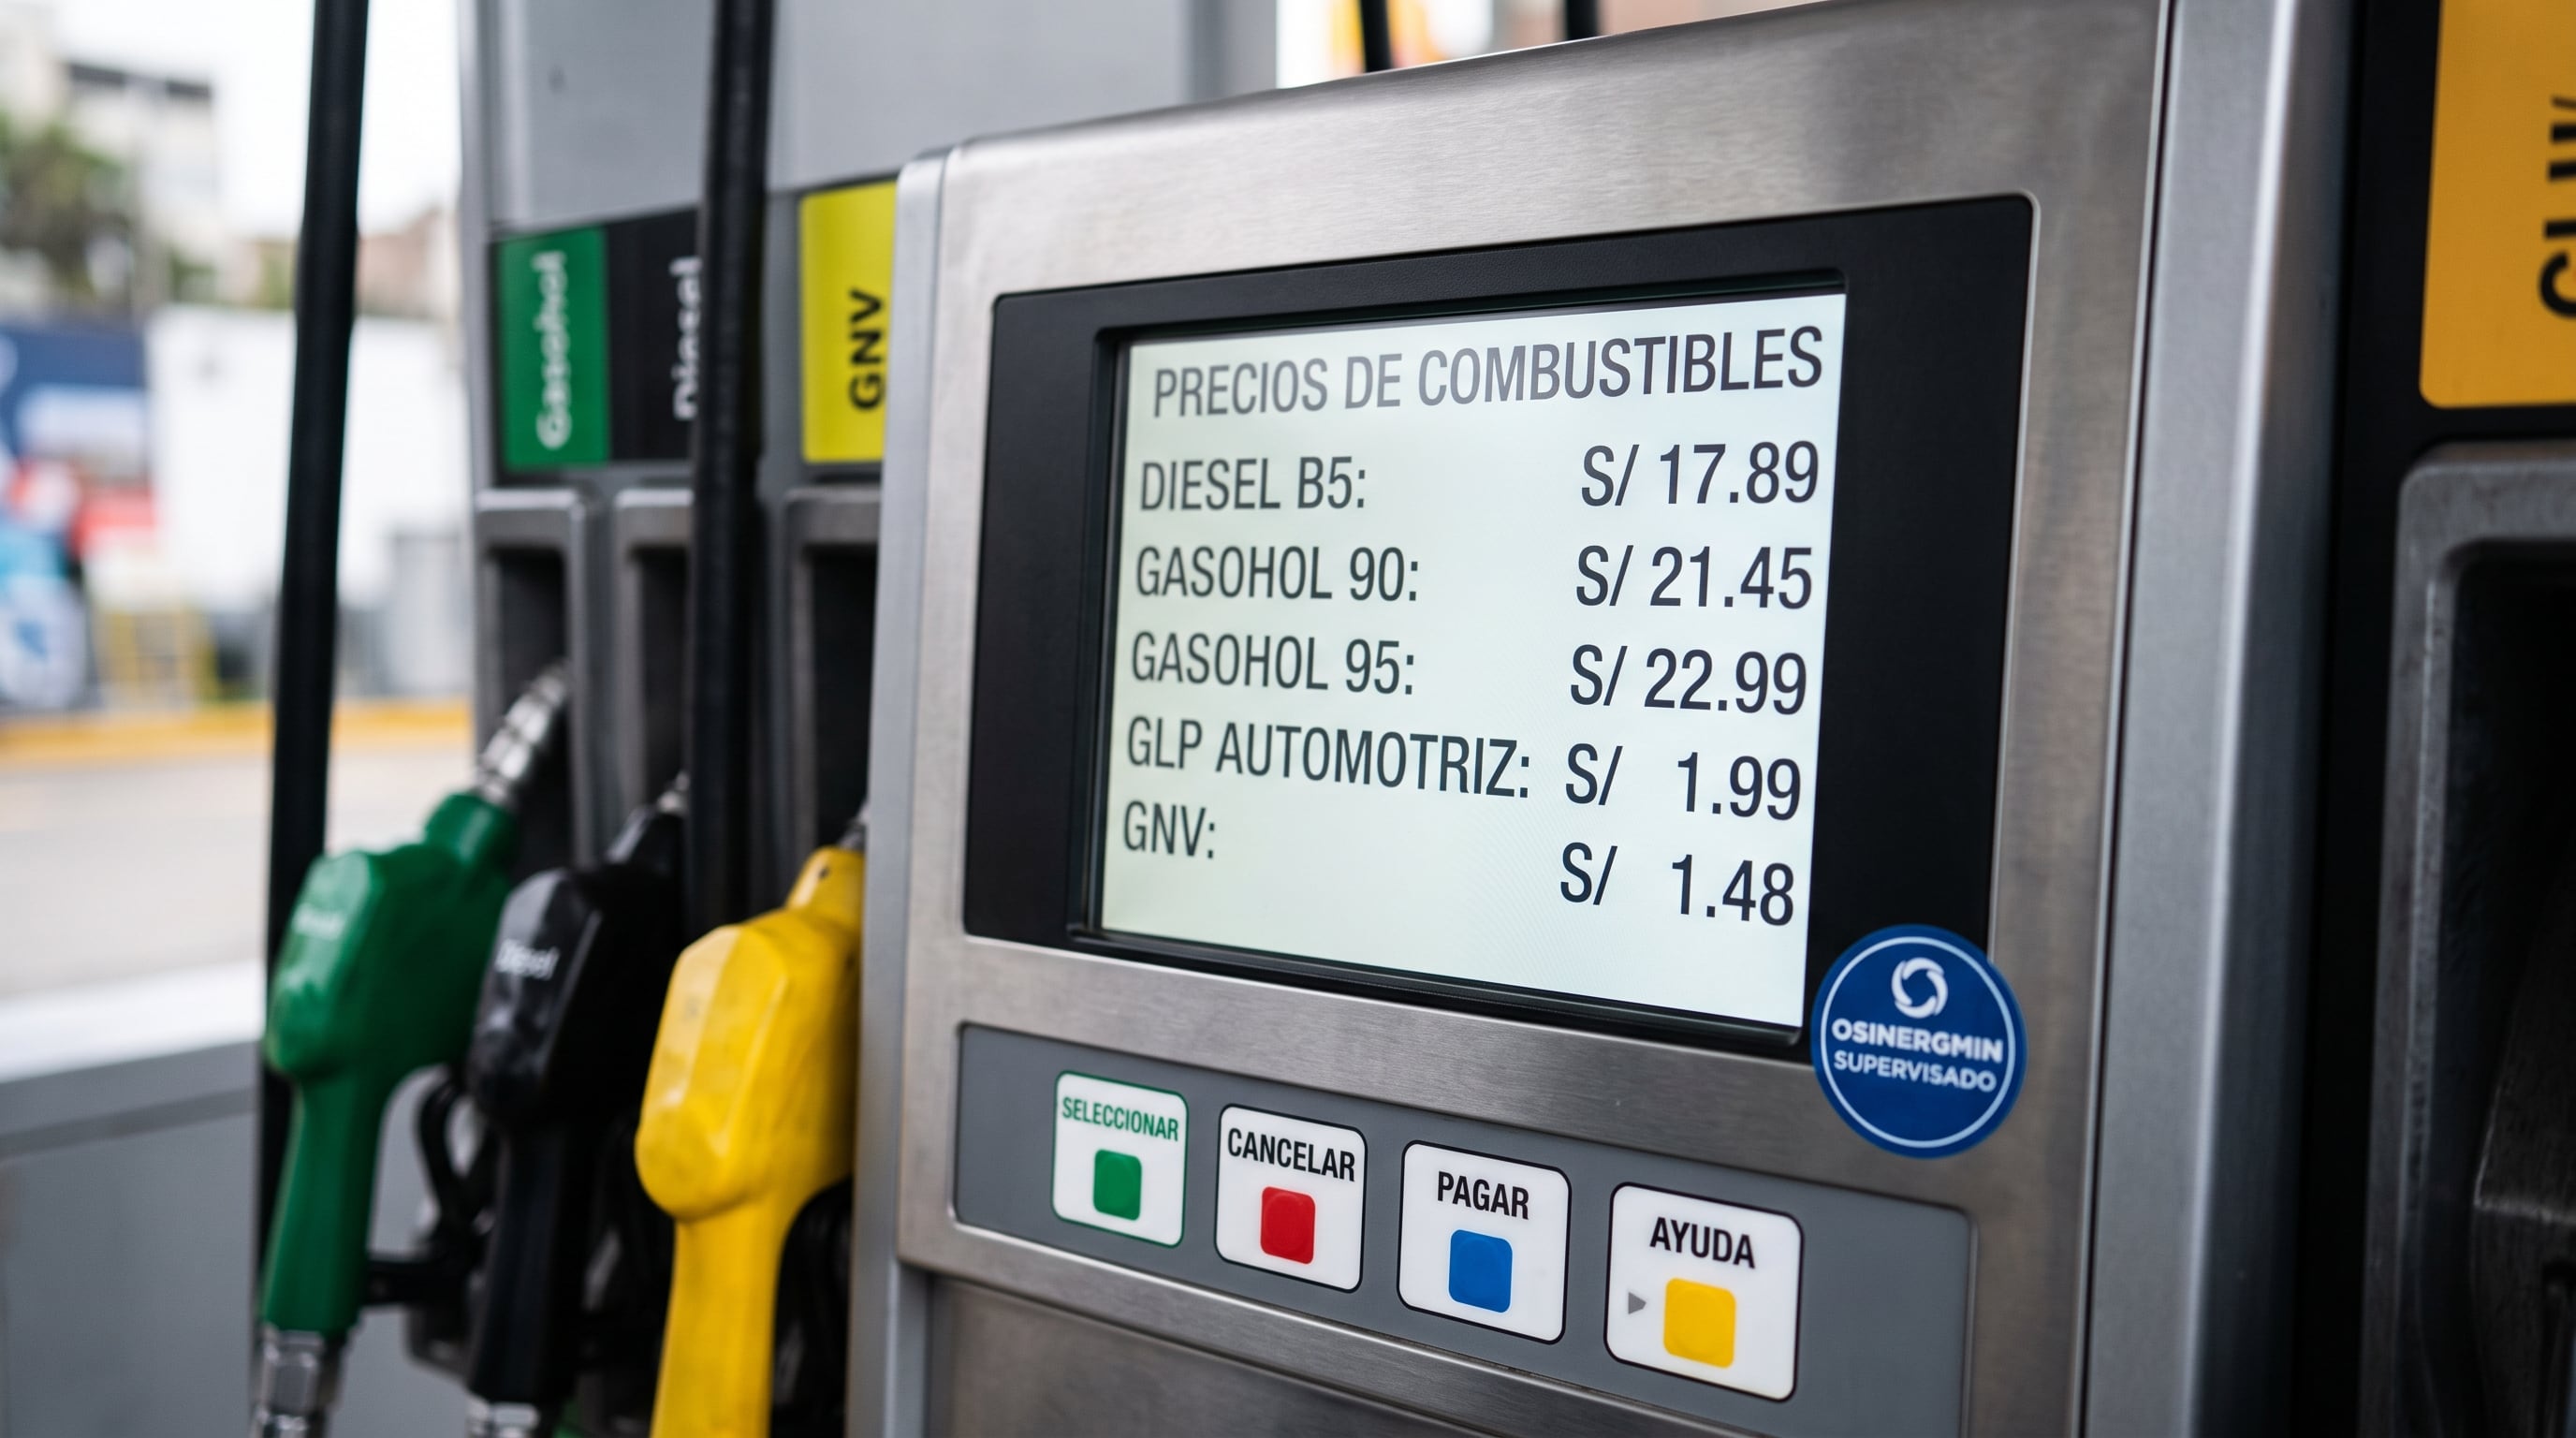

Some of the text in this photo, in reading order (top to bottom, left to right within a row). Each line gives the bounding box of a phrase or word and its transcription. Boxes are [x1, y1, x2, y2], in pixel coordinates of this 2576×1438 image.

[533, 251, 572, 450] Gasohol
[849, 288, 884, 411] GNV
[1152, 325, 1823, 418] PRECIOS DE COMBUSTIBLES
[1140, 440, 1820, 511] DIESEL B5: S/ 17.89
[1136, 545, 1813, 609] GASOHOL 90: S/ 21.45
[1131, 630, 1807, 715] GASOHOL 95: S/ 22.99
[1127, 714, 1801, 821] GLP AUTOMOTRIZ: S/ 1.99
[1122, 800, 1794, 927] GNV: S/ 1.48
[1831, 1018, 2004, 1064] OSINERGMIN
[1833, 1049, 1998, 1093] SUPERVISADO
[1061, 1095, 1180, 1142] SELECCIONAR
[1226, 1126, 1356, 1183] CANCELAR
[1437, 1170, 1530, 1221] PAGAR
[1648, 1215, 1756, 1270] AYUDA
